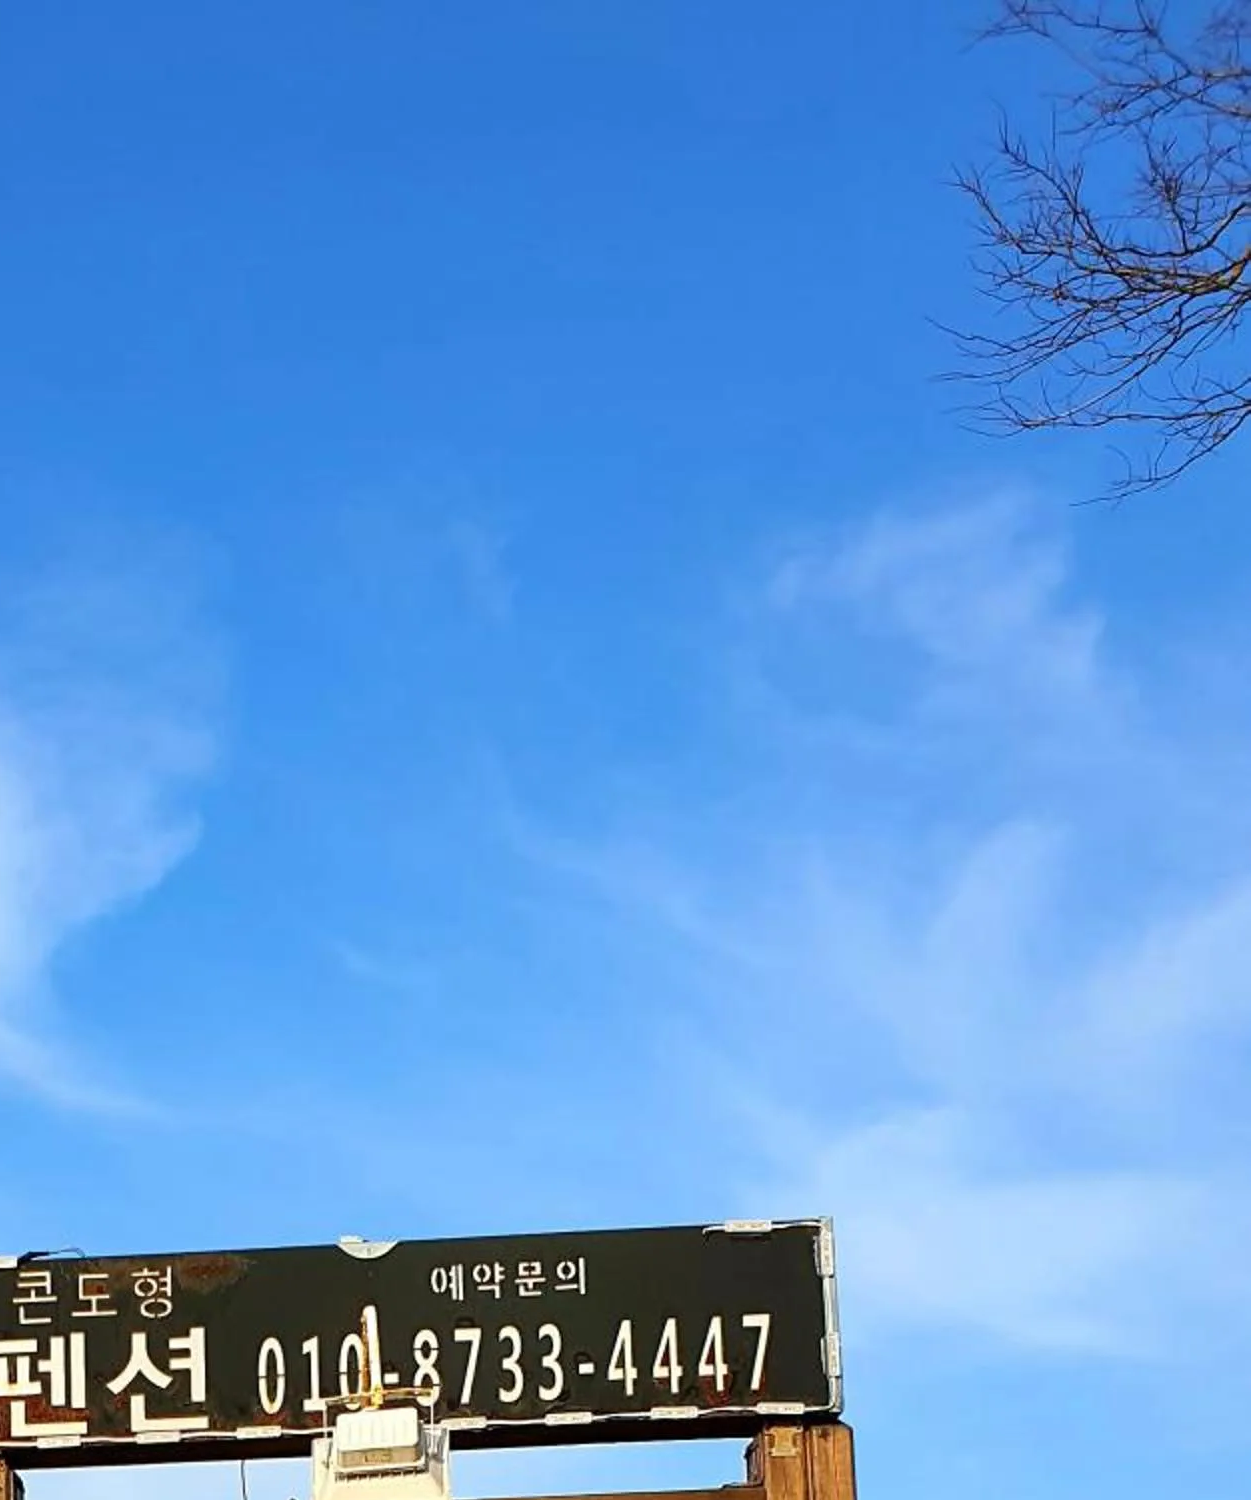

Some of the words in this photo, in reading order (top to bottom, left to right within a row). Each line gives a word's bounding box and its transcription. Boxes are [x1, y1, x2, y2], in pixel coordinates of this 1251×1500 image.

[12, 1264, 174, 1326] 콘도형
[430, 1257, 588, 1301] 예약문의
[257, 1313, 773, 1415] 010-8733-4447
